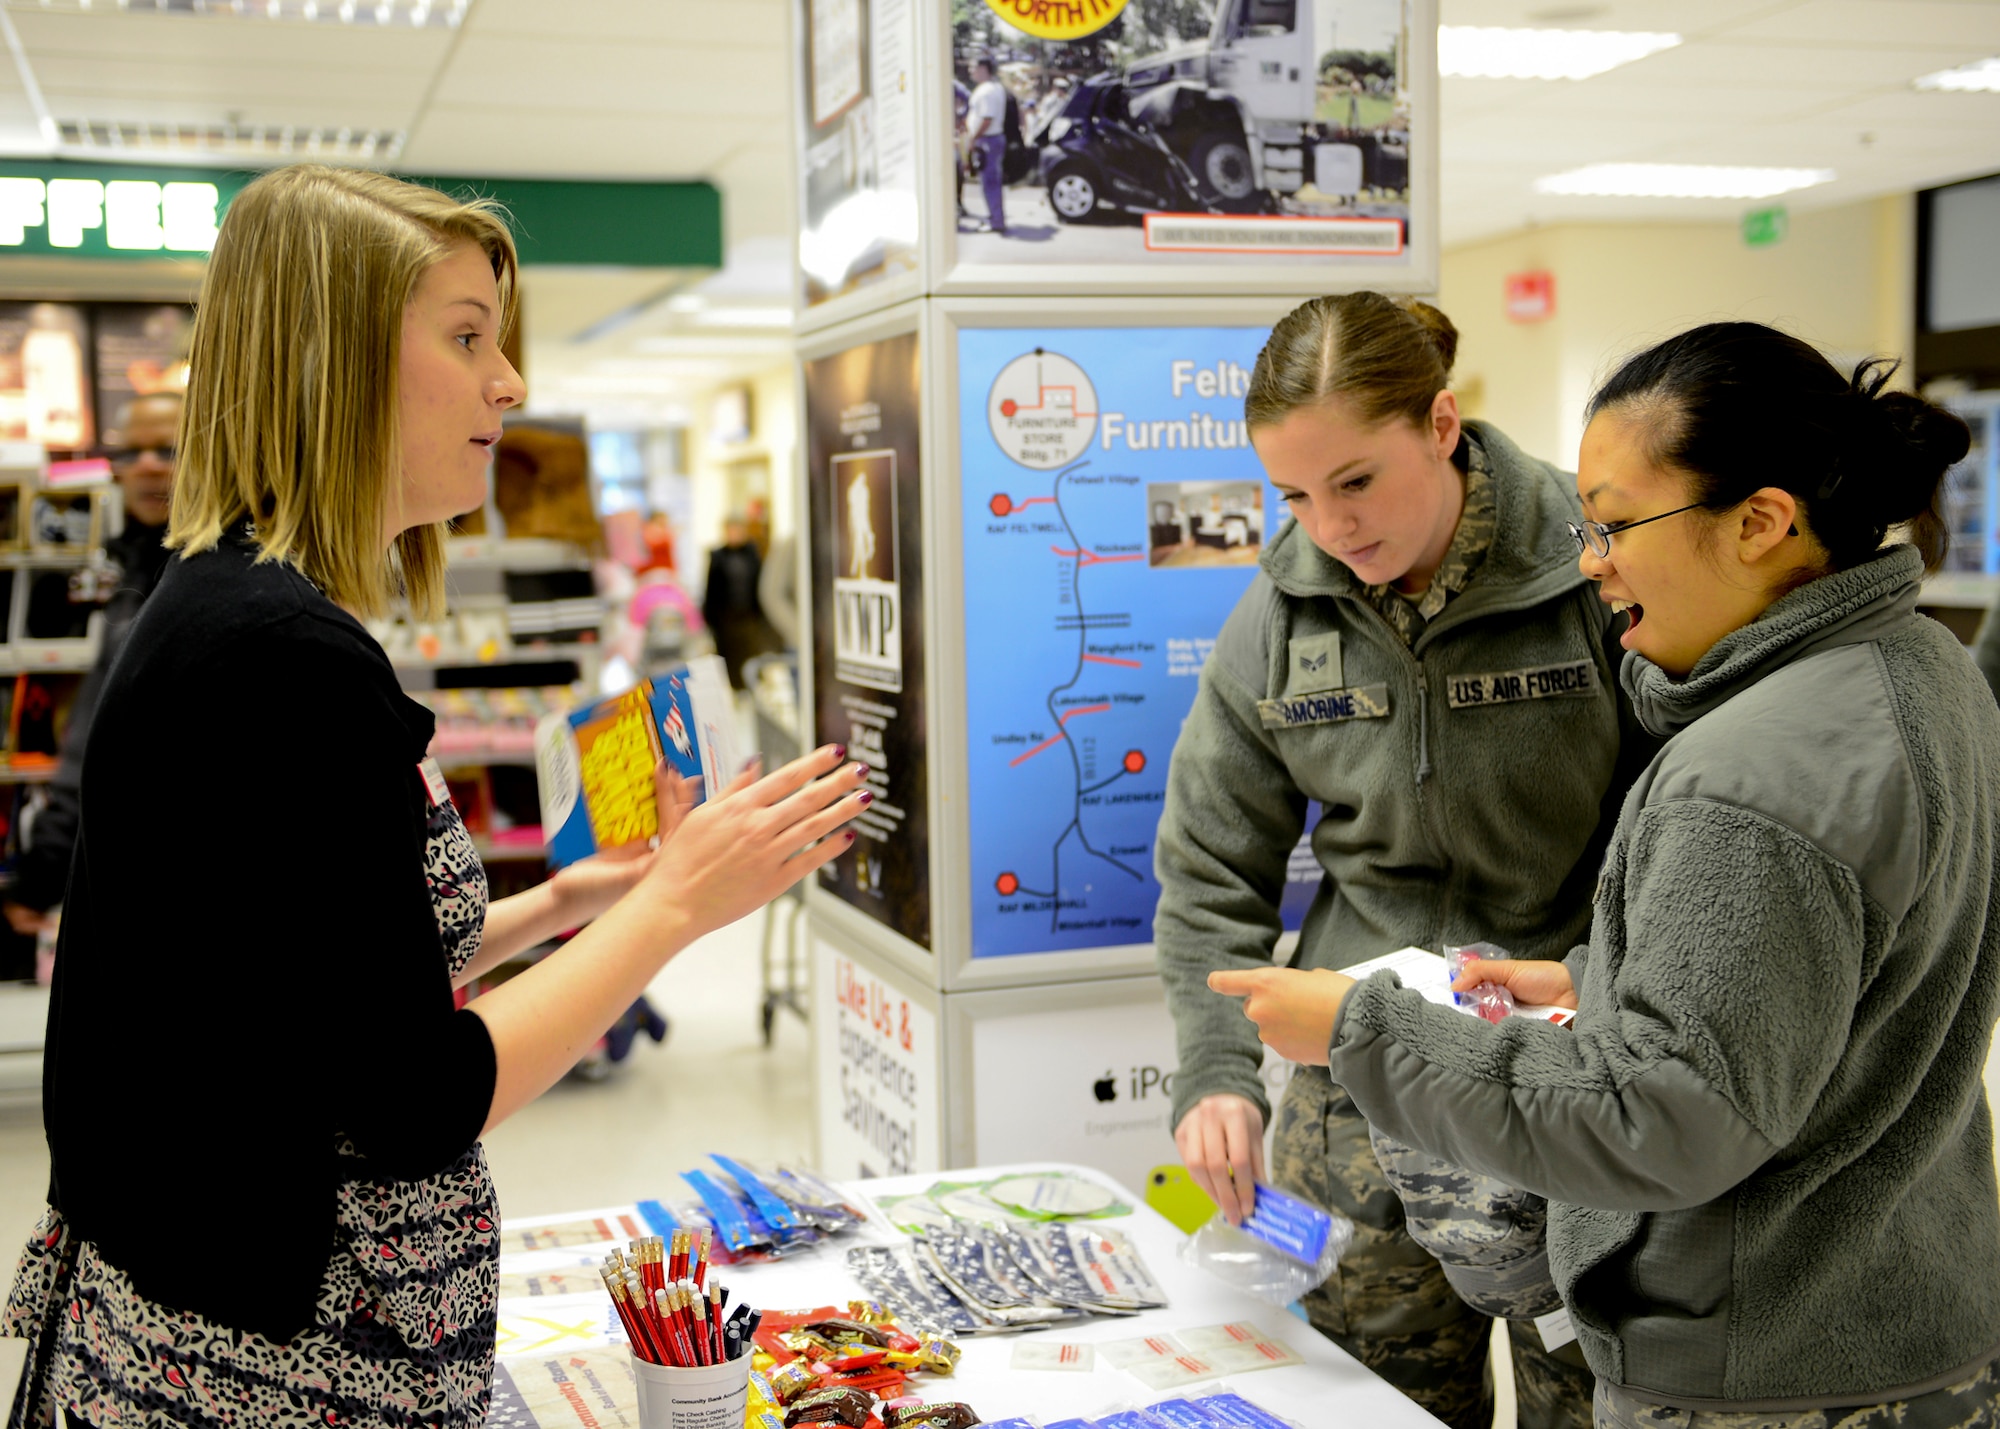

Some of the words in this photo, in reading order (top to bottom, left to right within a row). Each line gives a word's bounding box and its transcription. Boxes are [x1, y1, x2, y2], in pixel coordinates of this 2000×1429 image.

[1000, 0, 1084, 26] ORTH
[1007, 417, 1078, 430] FURNITURE
[1023, 432, 1065, 445] STORE
[1053, 447, 1067, 460] 71
[1109, 474, 1140, 485] Village
[987, 523, 1008, 535] RAF
[1492, 677, 1522, 700] AIR
[1526, 664, 1590, 696] FORCE
[1113, 693, 1146, 704] Village
[1284, 695, 1356, 724] AMORINE
[1082, 795, 1102, 806] RAF
[998, 902, 1018, 914] RAF
[1110, 915, 1143, 928] Village
[835, 957, 867, 1021] Like
[869, 978, 893, 1038] Us
[899, 1000, 914, 1053] &
[707, 1395, 722, 1403] Bank
[705, 1407, 727, 1416] Cashing
[686, 1417, 708, 1426] Regular
[709, 1412, 732, 1422] Checking
[705, 1420, 726, 1429] Banking
